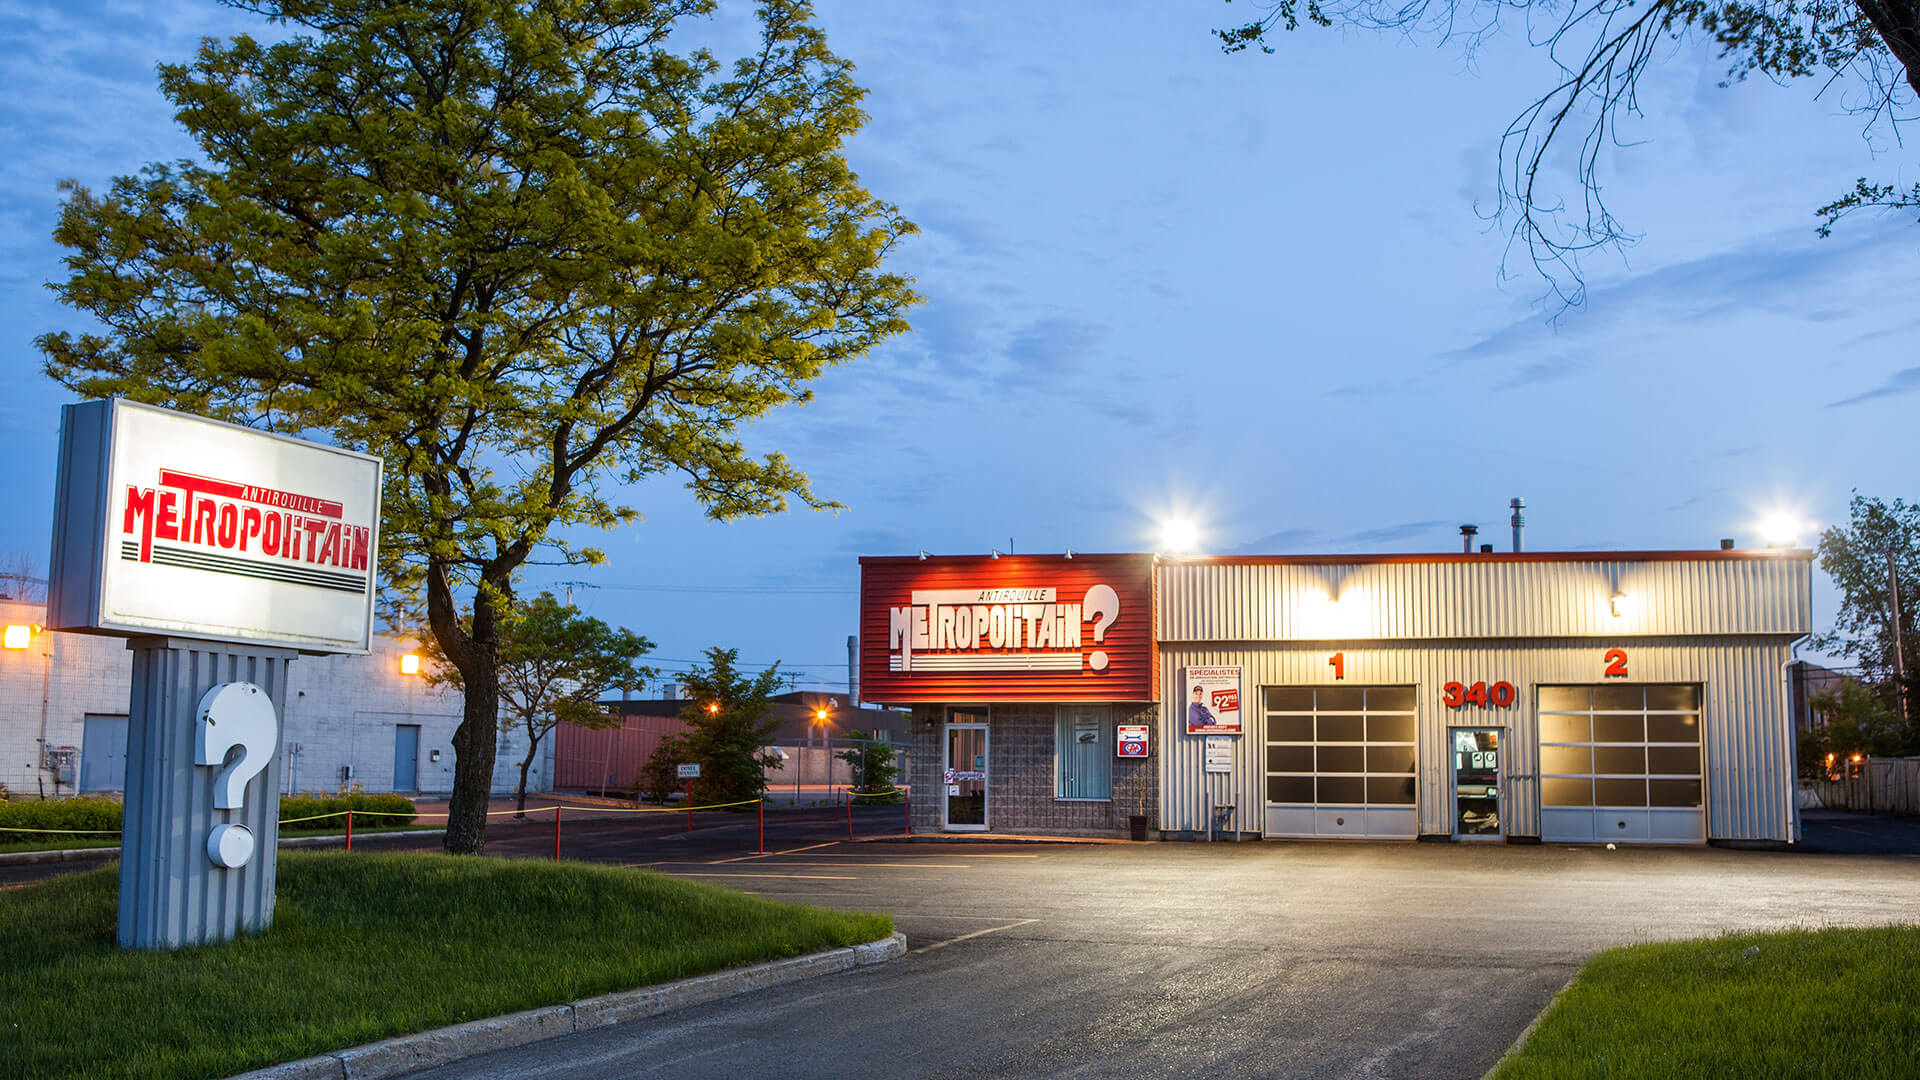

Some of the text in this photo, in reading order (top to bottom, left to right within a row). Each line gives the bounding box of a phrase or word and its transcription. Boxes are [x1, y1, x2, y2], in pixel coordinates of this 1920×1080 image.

[241, 486, 324, 513] ANTIROUILLE
[977, 589, 1047, 602] ANTIROUILLE
[1329, 652, 1344, 679] 1
[1604, 648, 1628, 677] 2
[1442, 681, 1515, 707] 340
